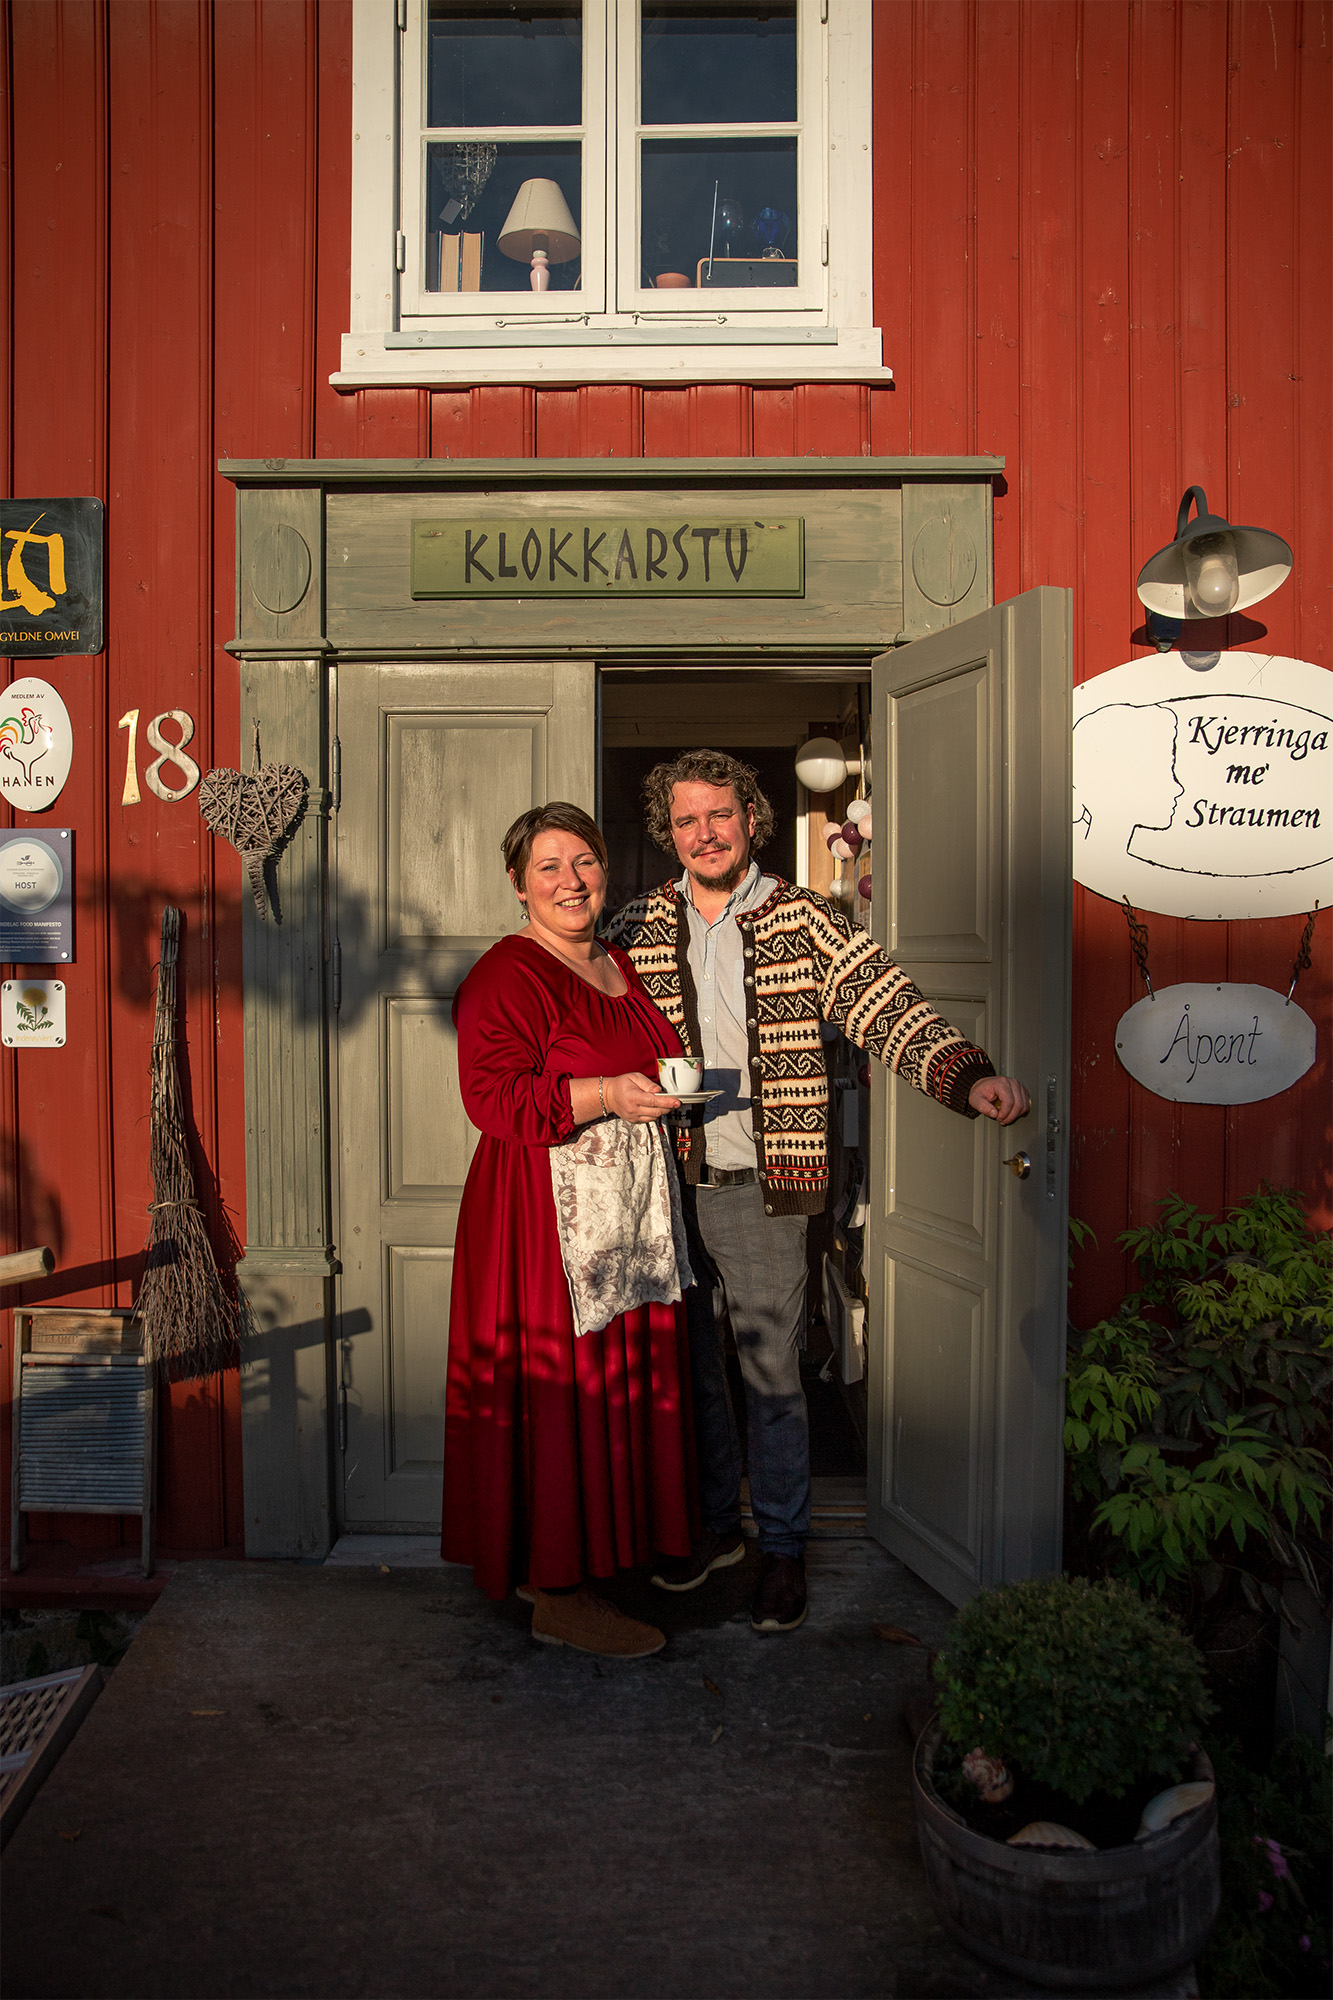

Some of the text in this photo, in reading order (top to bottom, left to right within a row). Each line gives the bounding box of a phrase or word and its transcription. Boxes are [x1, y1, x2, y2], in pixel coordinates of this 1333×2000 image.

[0, 630, 80, 641] GYLDNE OMVEI
[1188, 715, 1328, 760] Kjerringa
[118, 708, 200, 807] 18
[3, 775, 55, 788] HANEN
[1185, 799, 1321, 829] Straumen
[15, 881, 37, 889] HOST
[1159, 1004, 1263, 1083] Åpent
